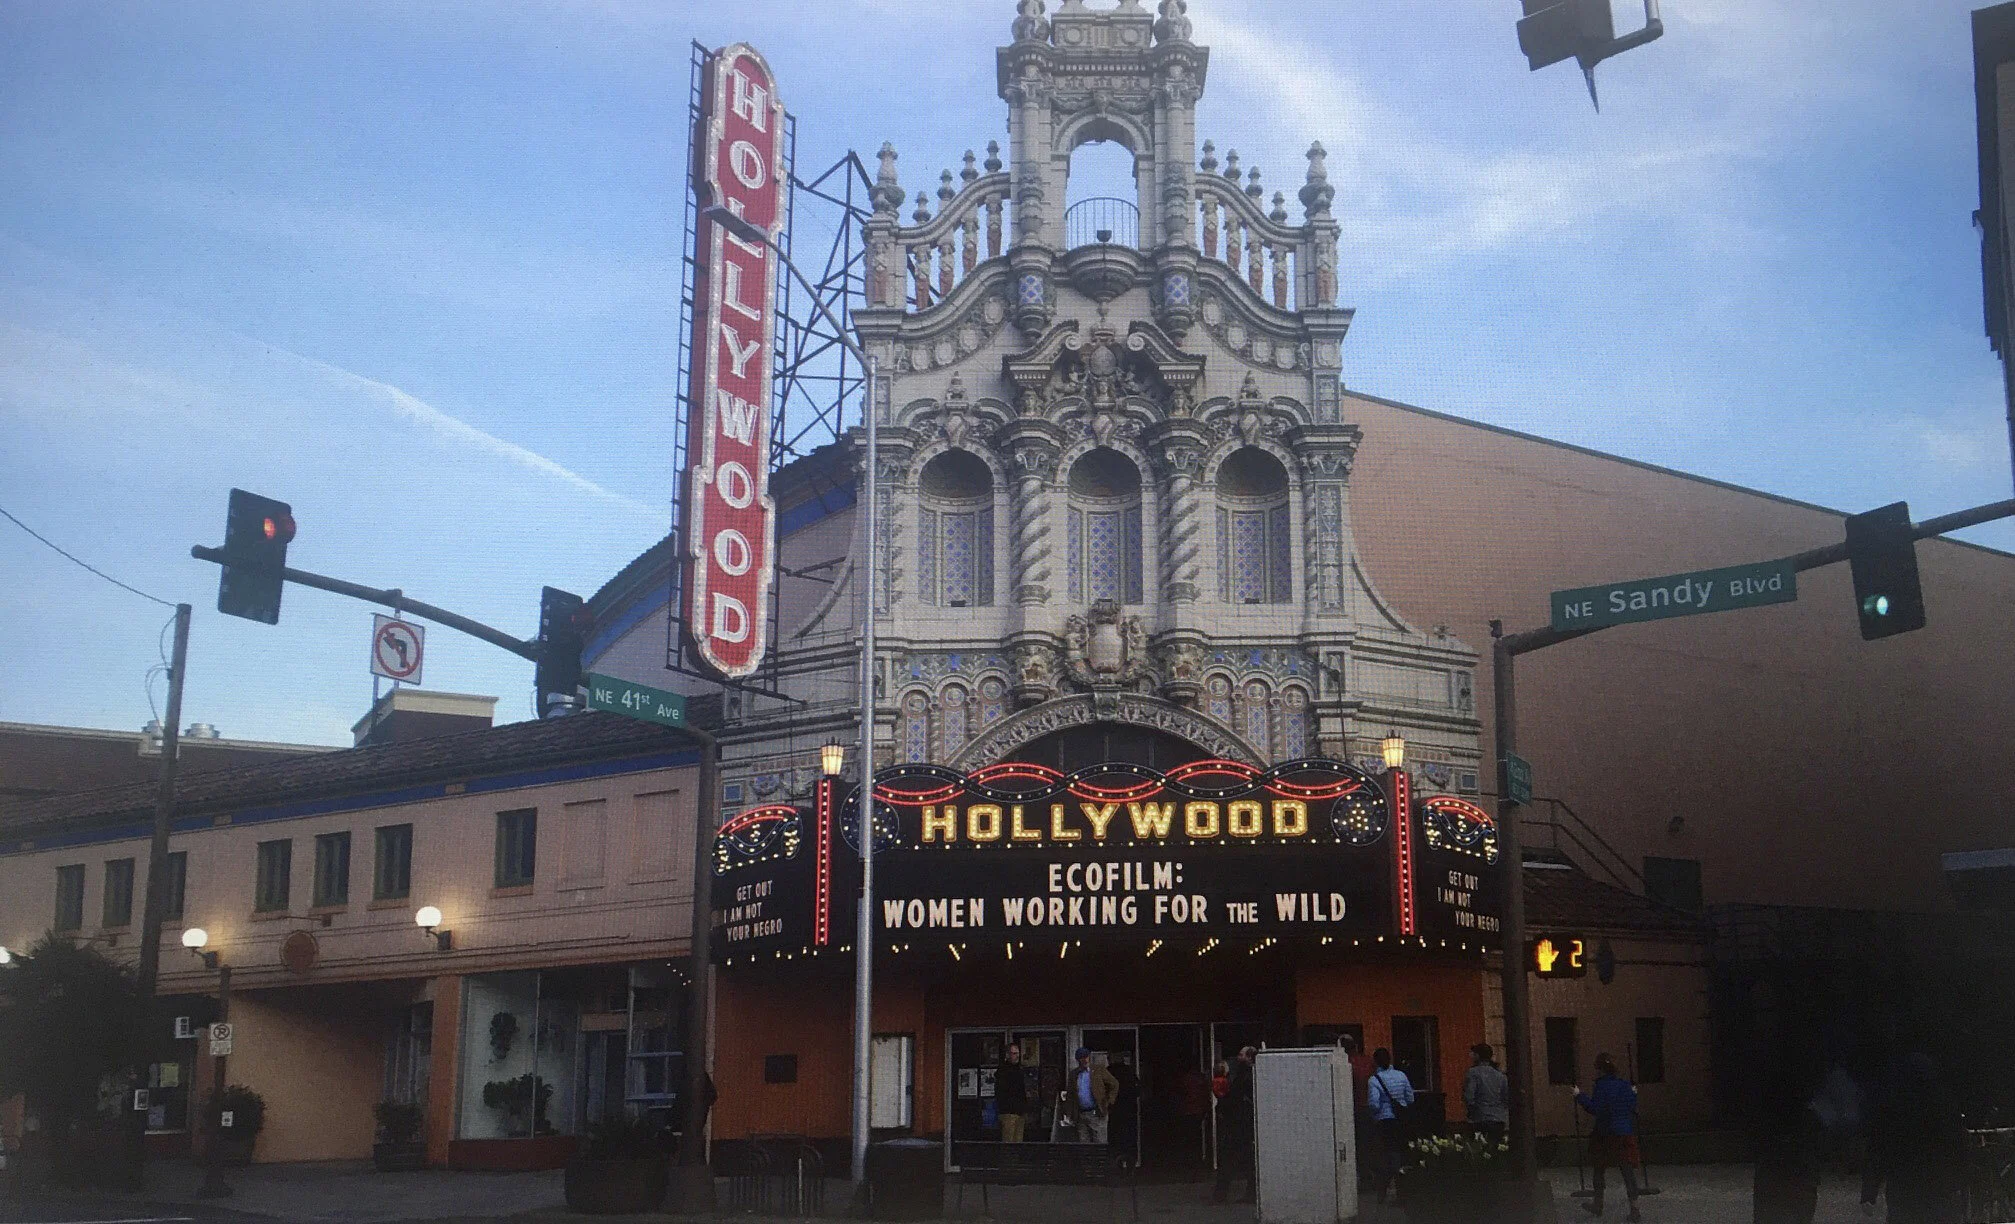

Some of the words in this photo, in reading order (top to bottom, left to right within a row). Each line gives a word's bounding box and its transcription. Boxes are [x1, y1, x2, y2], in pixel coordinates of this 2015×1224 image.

[712, 69, 767, 643] HOLLYWOOD
[1564, 602, 1593, 619] NE
[1609, 579, 1713, 613] Sandy
[1730, 574, 1782, 596] Blvd
[595, 688, 613, 704] NE
[621, 690, 650, 710] 41st
[657, 703, 679, 720] Ave
[922, 800, 1307, 842] HOLLYWOOD
[1049, 861, 1183, 892] ECOFILM:
[1449, 870, 1461, 885] GET
[1464, 874, 1479, 890] OUT
[737, 885, 752, 901] GET
[756, 881, 772, 897] OUT
[1444, 889, 1455, 905] AM
[1457, 890, 1471, 908] NOT
[724, 910, 727, 924] I
[730, 906, 743, 922] AM
[745, 902, 762, 919] NOT
[883, 898, 985, 928] WOMEN
[1002, 895, 1137, 927] WORKING
[1154, 894, 1209, 924] FOR
[1226, 902, 1259, 924] THE
[1275, 892, 1346, 922] WILD
[1455, 910, 1475, 927] YOUR
[1477, 914, 1500, 932] NEGRO
[727, 925, 750, 942] YOUR
[754, 919, 782, 937] NEGRO
[1571, 940, 1583, 968] 2
